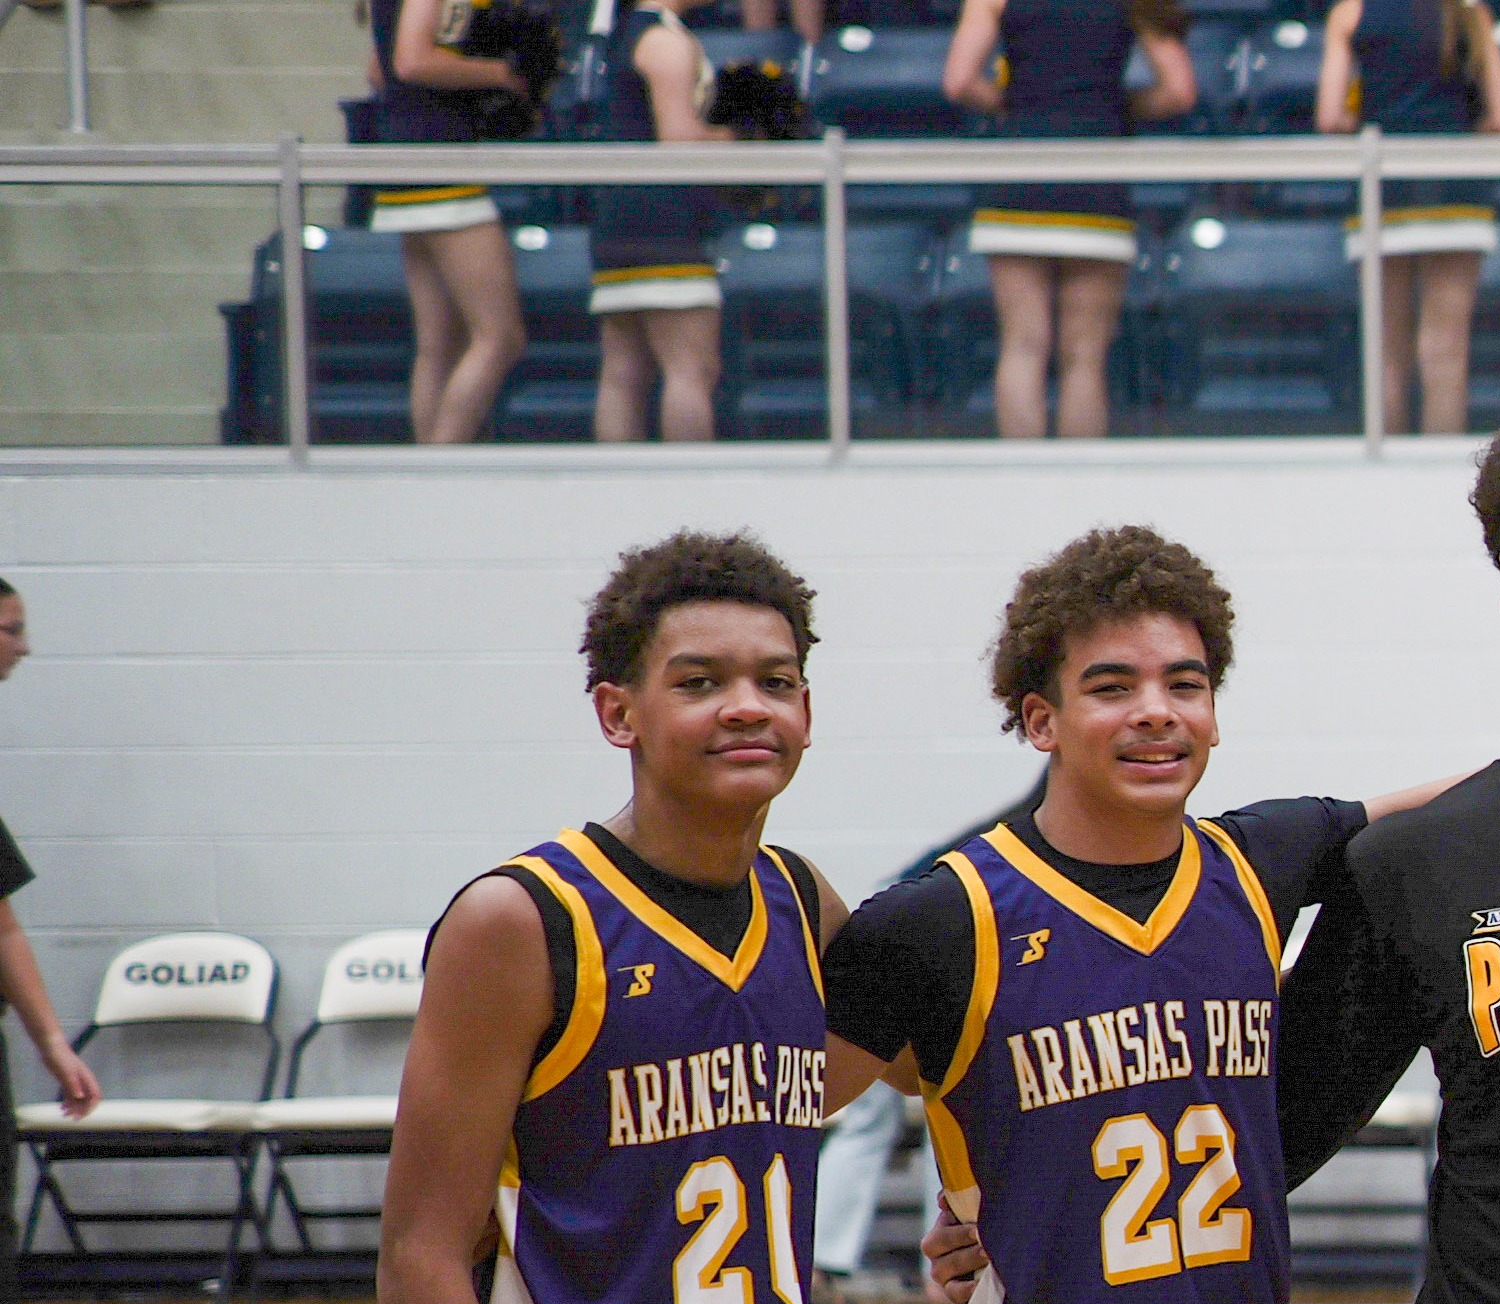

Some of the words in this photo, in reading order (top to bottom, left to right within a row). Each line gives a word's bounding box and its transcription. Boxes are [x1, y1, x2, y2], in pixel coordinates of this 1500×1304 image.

[124, 961, 250, 986] GOLIAD
[346, 959, 424, 983] GOL
[776, 1043, 826, 1128] PASS
[1007, 1000, 1193, 1112] ARANSAS
[1204, 999, 1272, 1077] PASS
[1091, 1103, 1252, 1286] 22
